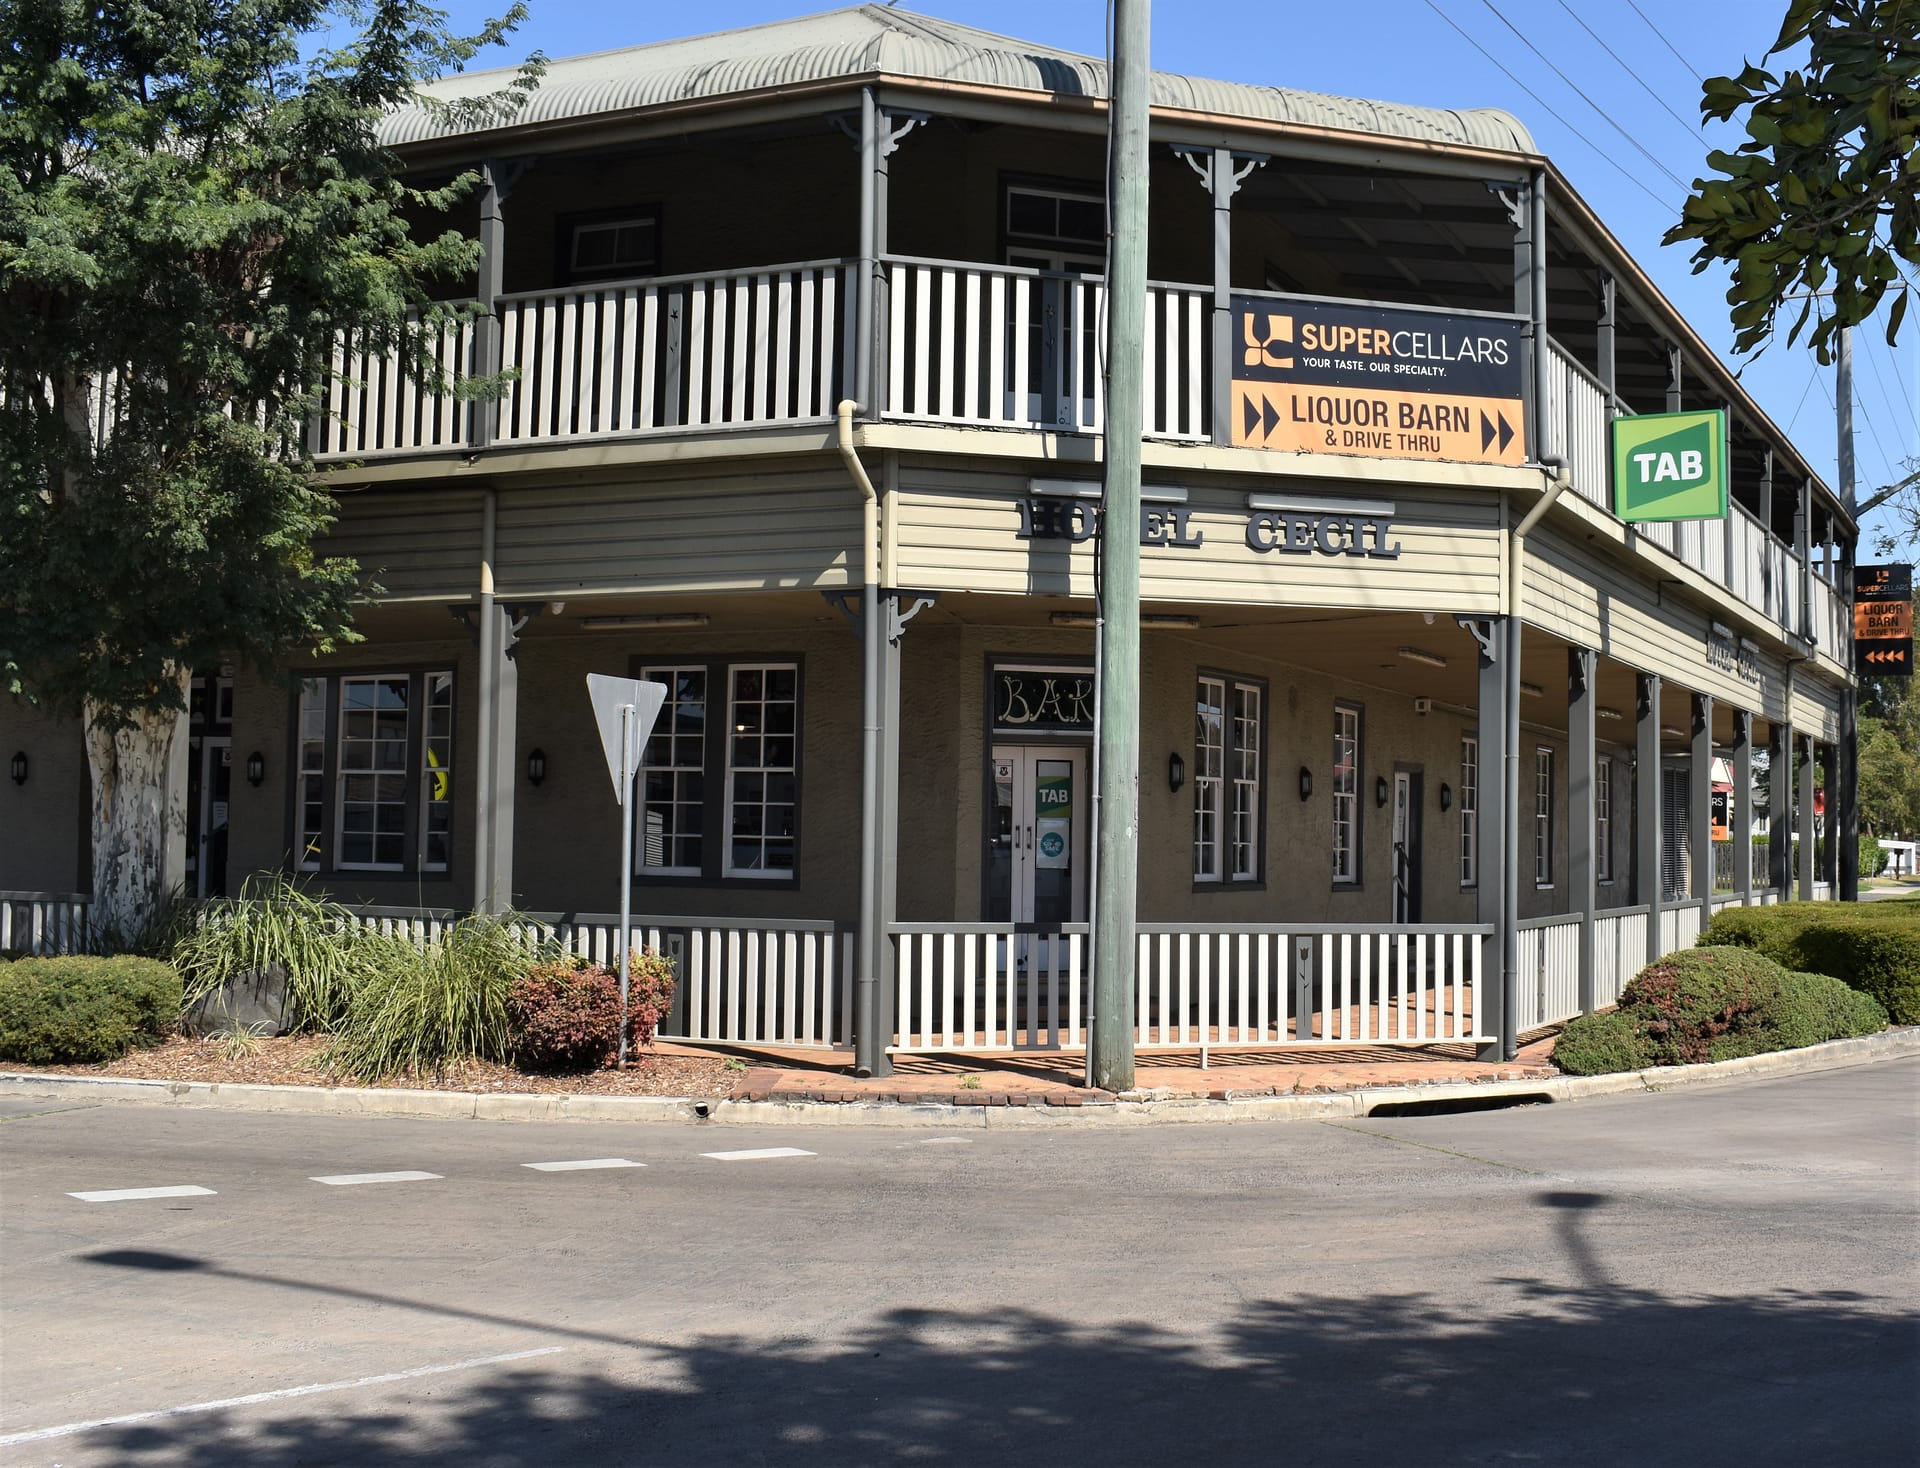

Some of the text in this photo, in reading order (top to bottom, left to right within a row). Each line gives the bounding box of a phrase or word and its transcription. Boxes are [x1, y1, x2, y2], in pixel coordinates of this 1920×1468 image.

[1302, 323, 1508, 365] SUPERCELLARS
[1302, 357, 1447, 377] YOUR TASTE. OUR SPECIALTY.
[1292, 394, 1470, 433] LIQUOR BARN
[1325, 429, 1441, 453] & DRIVE THRU
[1633, 450, 1703, 483] TAB
[1016, 499, 1401, 557] HOEL CECIL
[1863, 604, 1903, 616] LIQUOR
[1869, 616, 1899, 627] BARN
[1890, 627, 1910, 636] THRU
[998, 675, 1093, 724] BAR
[1039, 789, 1068, 803] TAB
